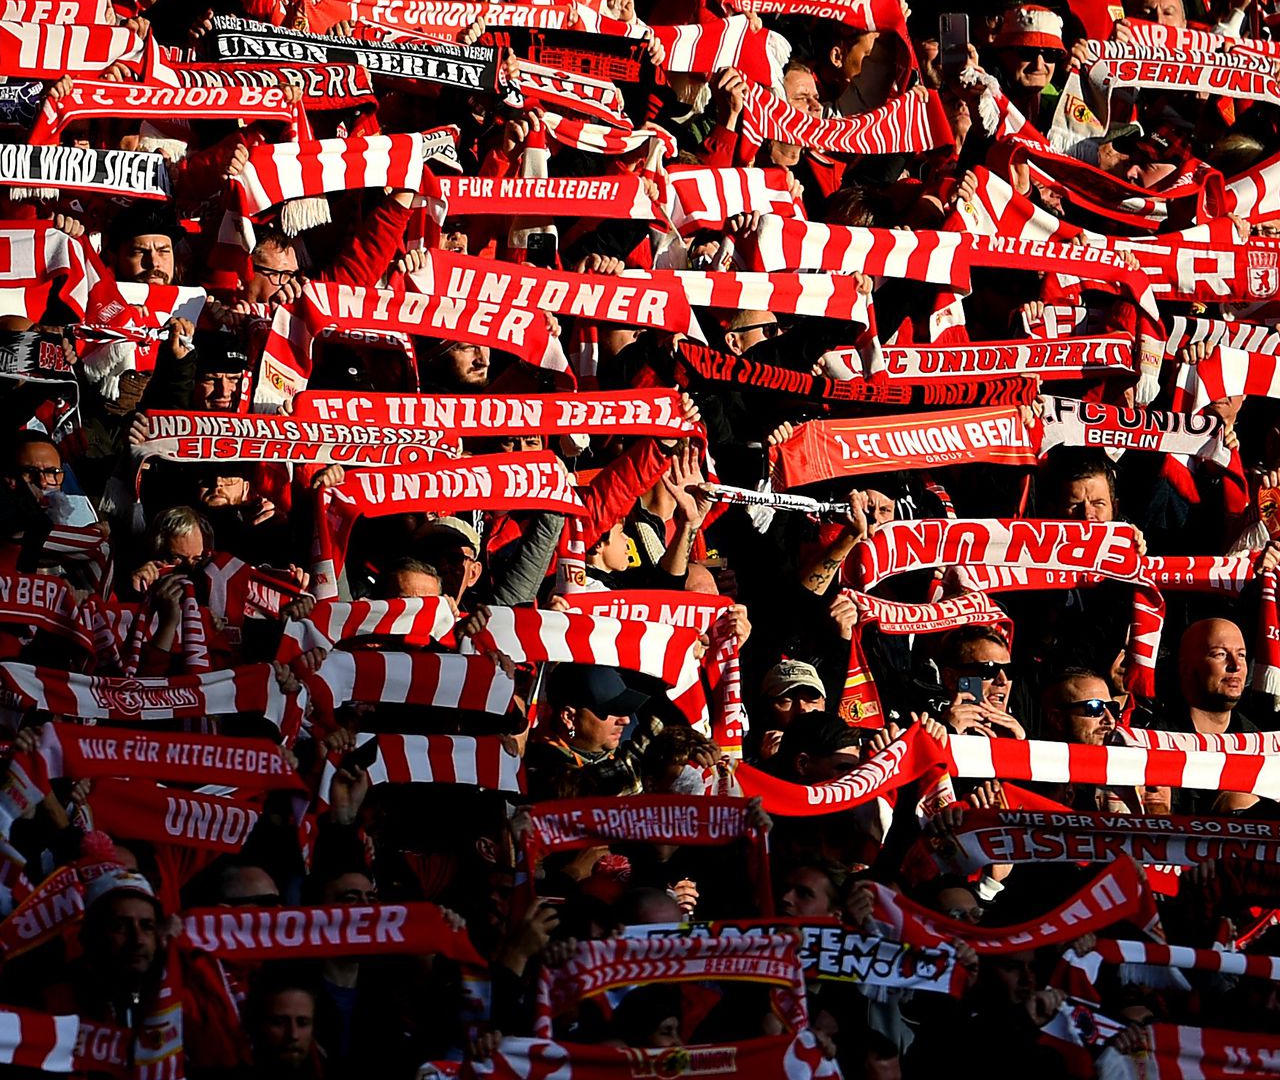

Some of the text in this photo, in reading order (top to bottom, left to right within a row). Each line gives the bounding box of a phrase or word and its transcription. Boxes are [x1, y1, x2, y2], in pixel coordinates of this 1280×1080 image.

[409, 0, 488, 26] UNION
[790, 2, 846, 21] UNION
[219, 39, 485, 88] UNION BERLIN
[40, 150, 98, 182] WIRD
[455, 176, 619, 201] FÜR MITGLIEDER!
[449, 268, 669, 328] UNIONER
[918, 346, 1022, 372] UNION
[387, 396, 542, 428] UNION
[190, 418, 300, 440] NIEMALS
[1088, 430, 1160, 448] BERLIN
[178, 438, 320, 460] EISERN
[860, 428, 962, 458] FC UNION
[79, 738, 161, 765] NUR FÜR
[1000, 810, 1036, 825] WIE
[1051, 815, 1094, 829] DER
[1102, 818, 1172, 832] VATER
[1194, 821, 1220, 833] SO
[1228, 824, 1270, 838] DER
[975, 828, 1170, 862] EISERN
[184, 905, 408, 952] UNIONER
[704, 959, 790, 975] BERLIN IST
